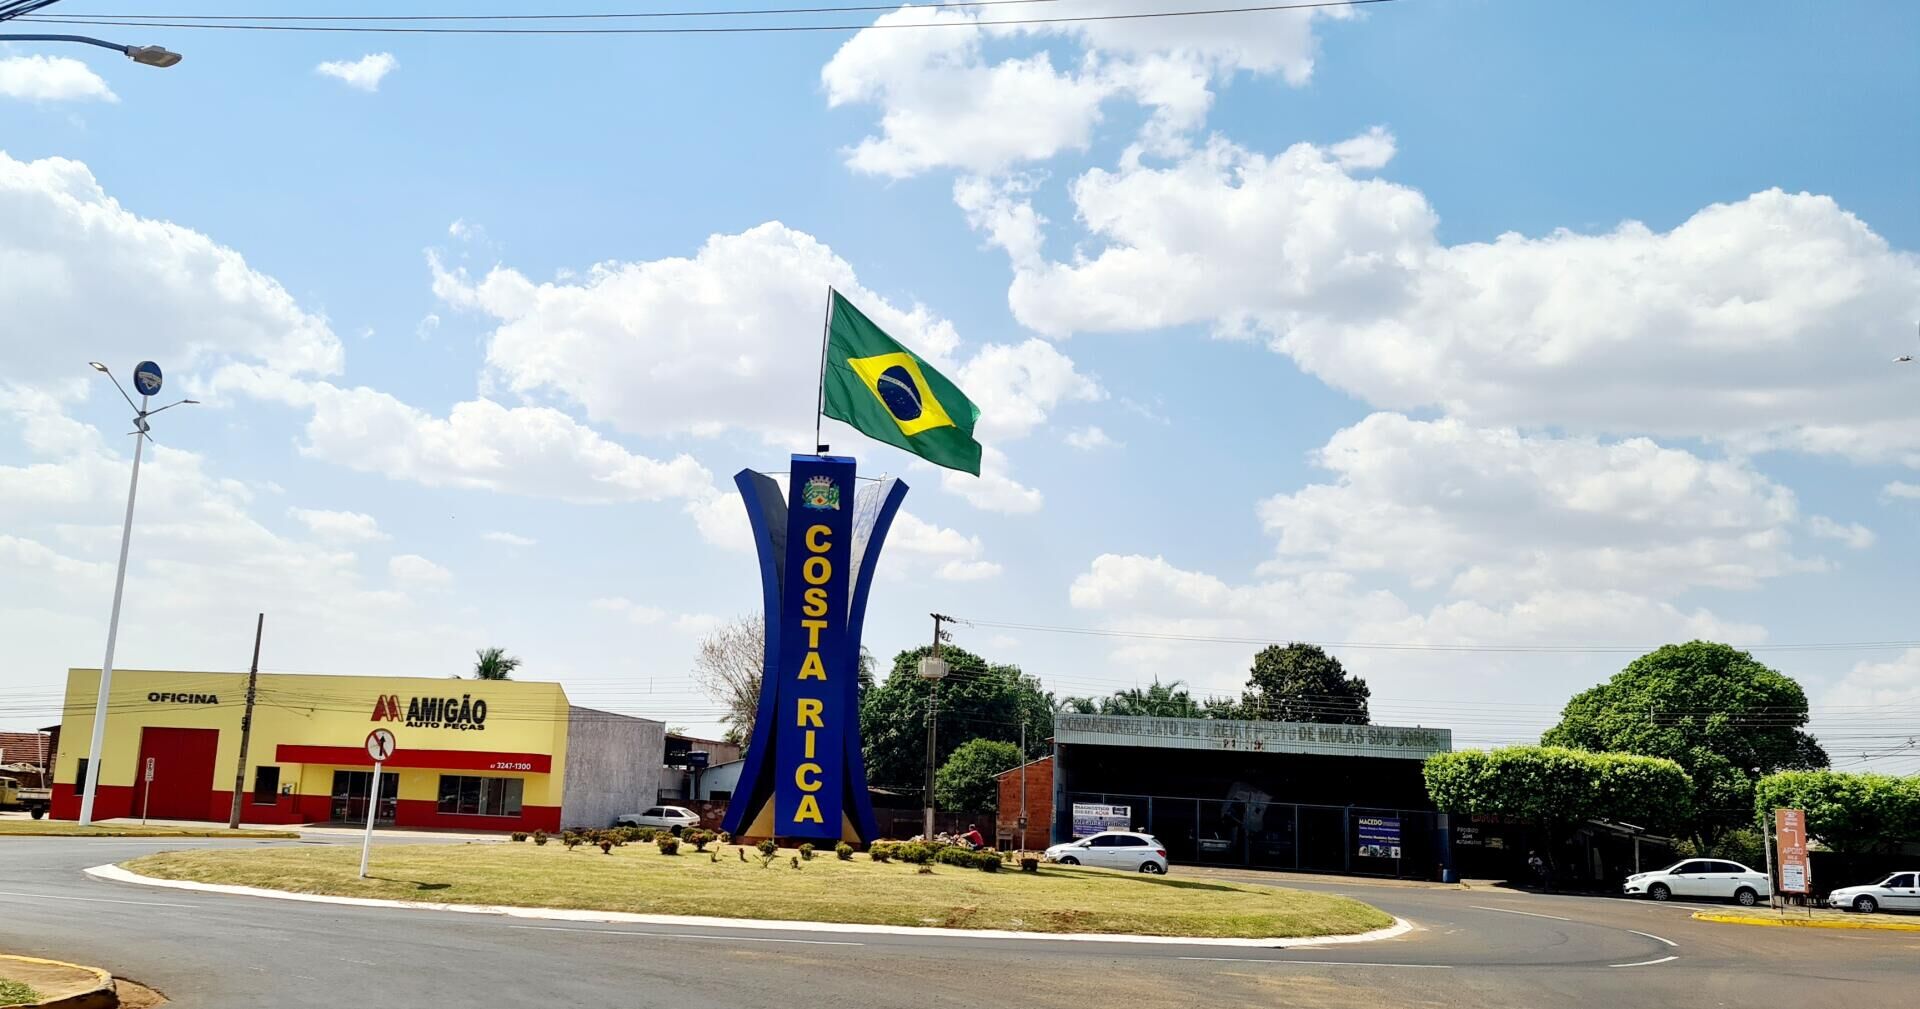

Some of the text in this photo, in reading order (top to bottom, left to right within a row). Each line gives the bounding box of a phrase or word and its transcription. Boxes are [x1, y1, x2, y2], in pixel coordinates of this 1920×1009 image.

[793, 524, 832, 823] COSTA RICA
[148, 692, 219, 704] OFICINA
[406, 694, 487, 724] AMIGÃO
[443, 723, 485, 731] PEÇAS
[1299, 727, 1316, 742] DE
[1319, 727, 1364, 745] MOLAS
[496, 762, 532, 770] 3247-1300
[1359, 818, 1383, 826] MACEDO
